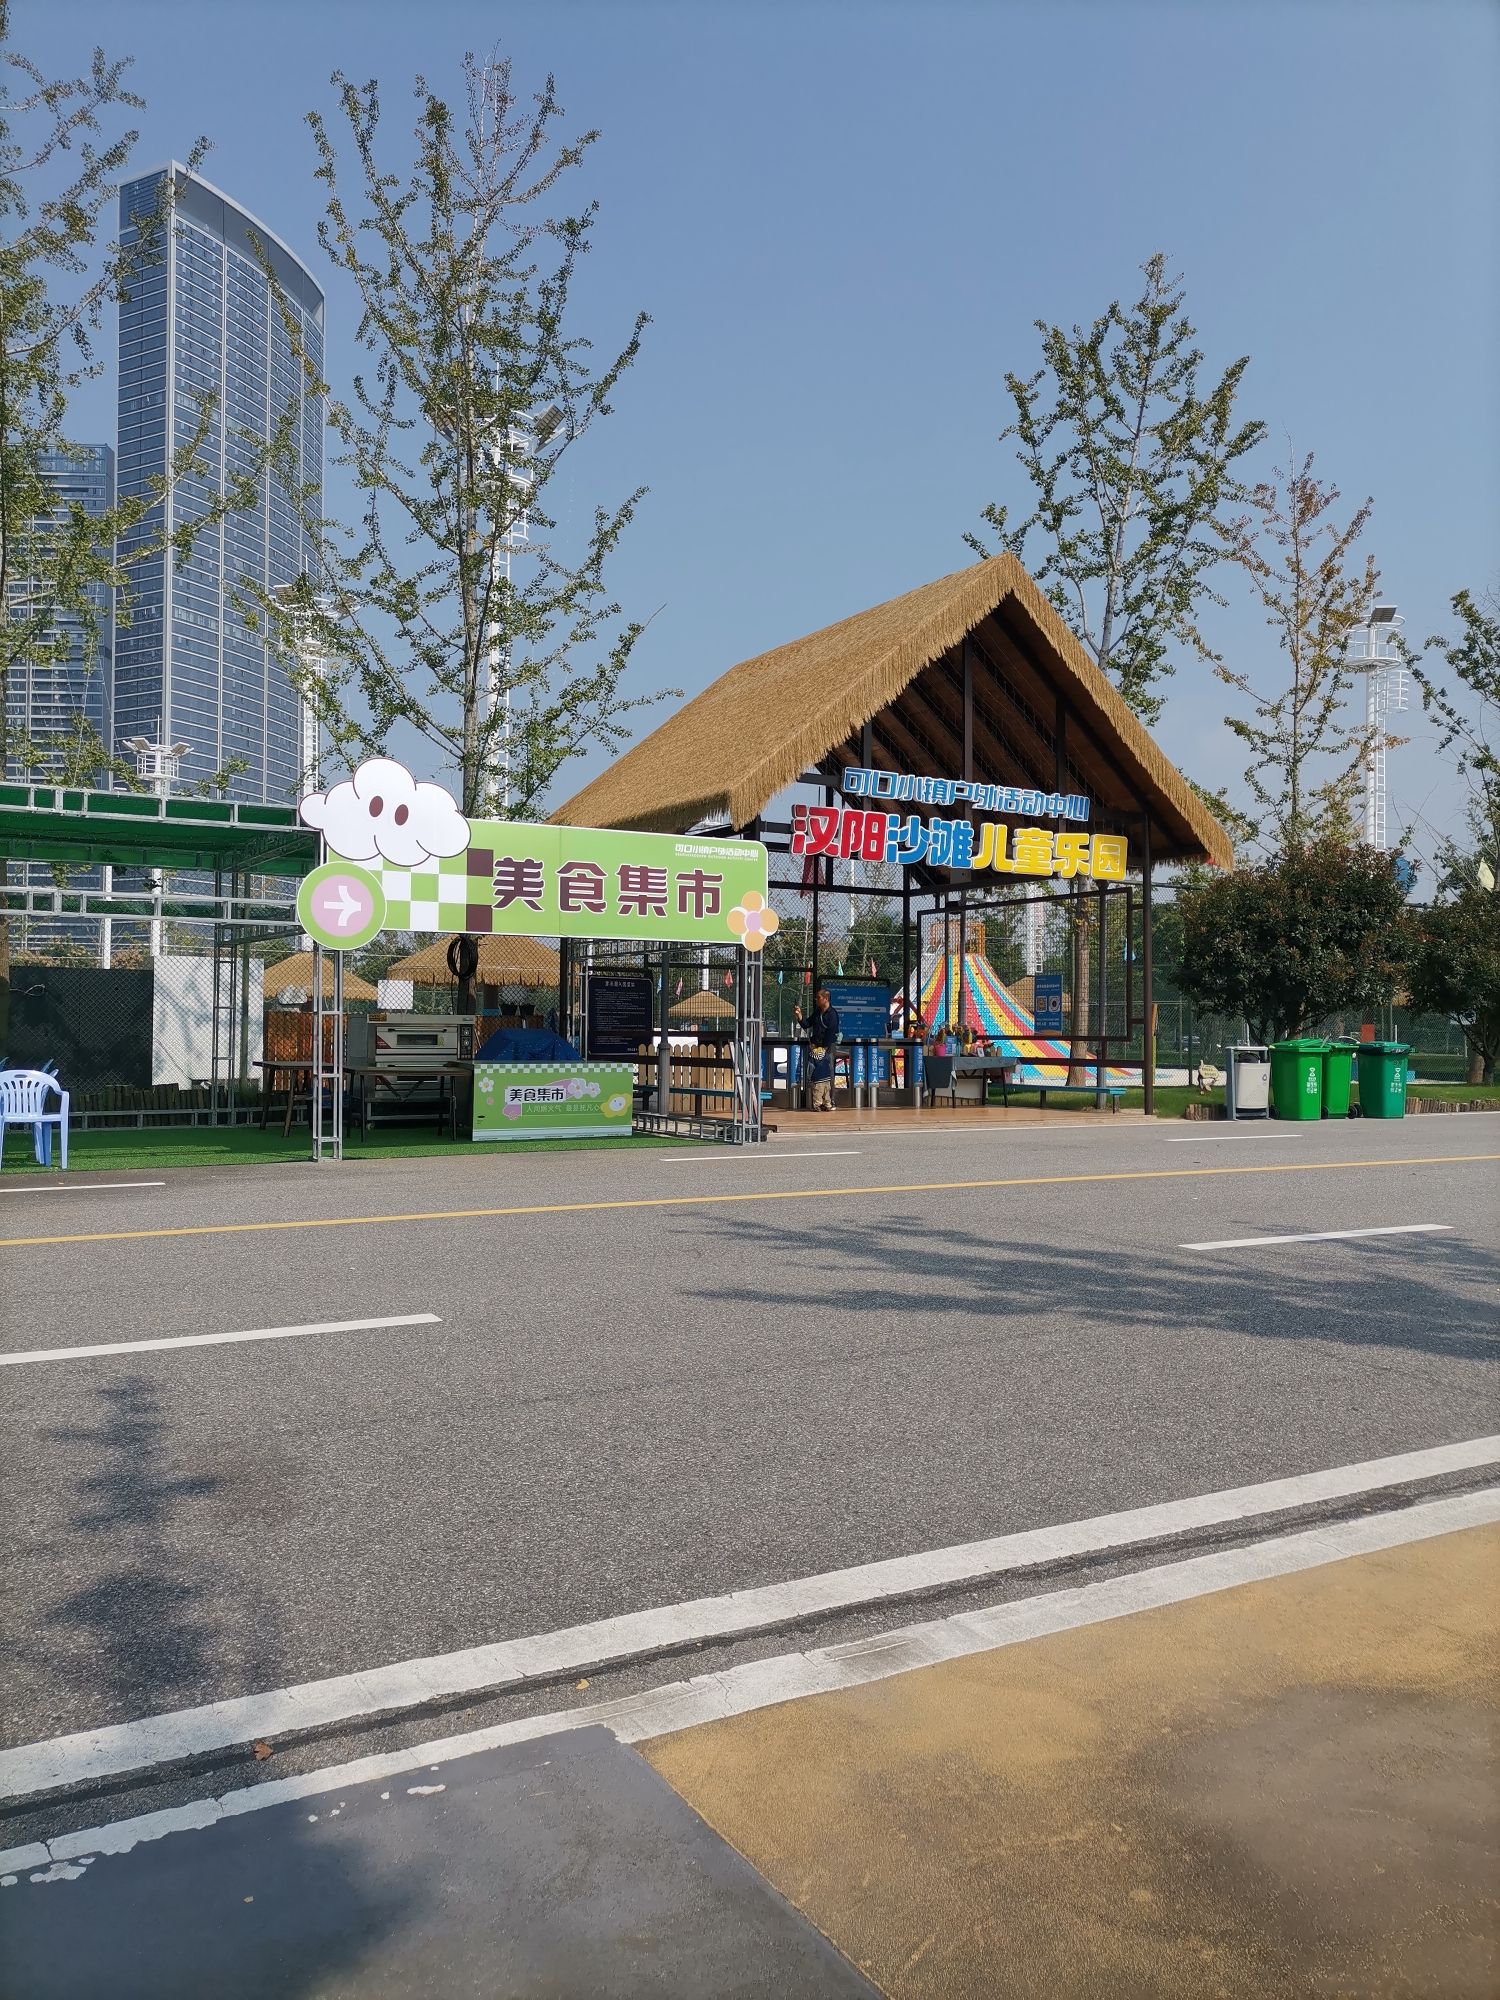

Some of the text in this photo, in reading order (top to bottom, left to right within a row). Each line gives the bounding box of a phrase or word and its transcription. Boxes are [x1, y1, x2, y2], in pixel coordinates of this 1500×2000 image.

[842, 767, 1091, 821] 可口小镇户外活动中心
[675, 843, 759, 858] 可口小镇户外活动中心
[791, 803, 1128, 880] 汉阳沙滩儿童乐园
[492, 855, 723, 919] 美食集市
[509, 1088, 565, 1102] 美食集市
